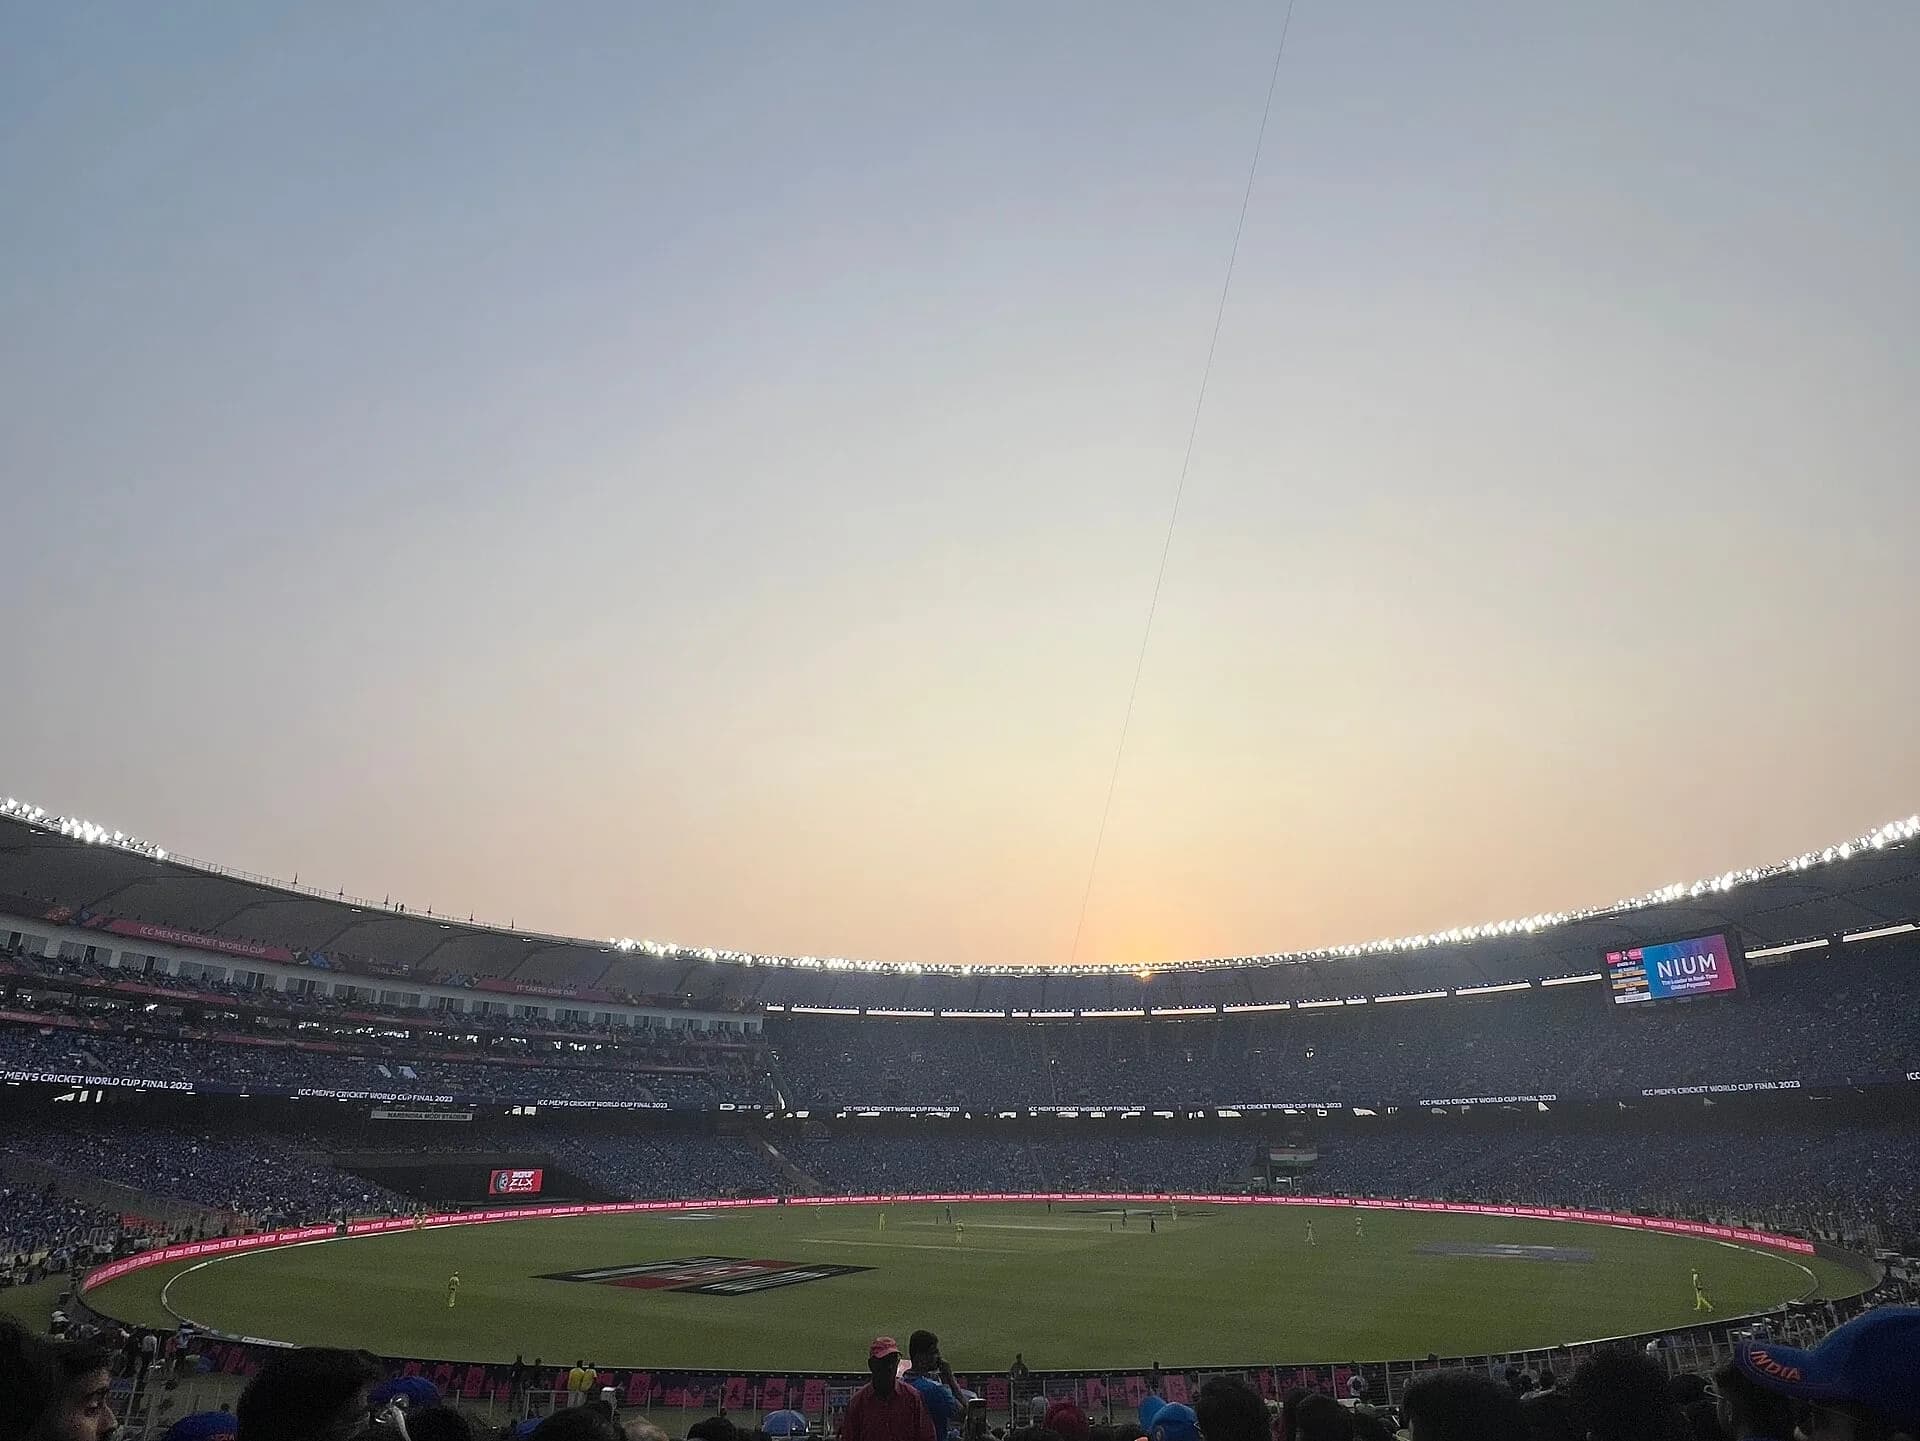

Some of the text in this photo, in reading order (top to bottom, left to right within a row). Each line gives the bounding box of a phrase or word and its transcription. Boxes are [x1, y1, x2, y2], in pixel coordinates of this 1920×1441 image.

[139, 926, 153, 936] ICC
[181, 933, 217, 946] CRICKET
[218, 940, 248, 951] WORLD
[249, 945, 265, 953] CUP
[1657, 953, 1716, 978] NIUM
[5, 1071, 39, 1081] MEN'S
[40, 1073, 83, 1084] CRICKET
[85, 1076, 119, 1086] WORLD
[121, 1078, 140, 1087] CUP
[141, 1079, 169, 1089] FINAL
[170, 1081, 193, 1090] 2023
[1678, 1086, 1708, 1094] CRICKET
[1710, 1084, 1737, 1092] WORLD
[1738, 1083, 1753, 1091] CUP
[1754, 1082, 1778, 1090] FINAL
[1779, 1080, 1800, 1088] 2023
[370, 1092, 396, 1100] WORLD
[413, 1094, 434, 1102] FINAL
[1751, 1350, 1800, 1381] INDIA
